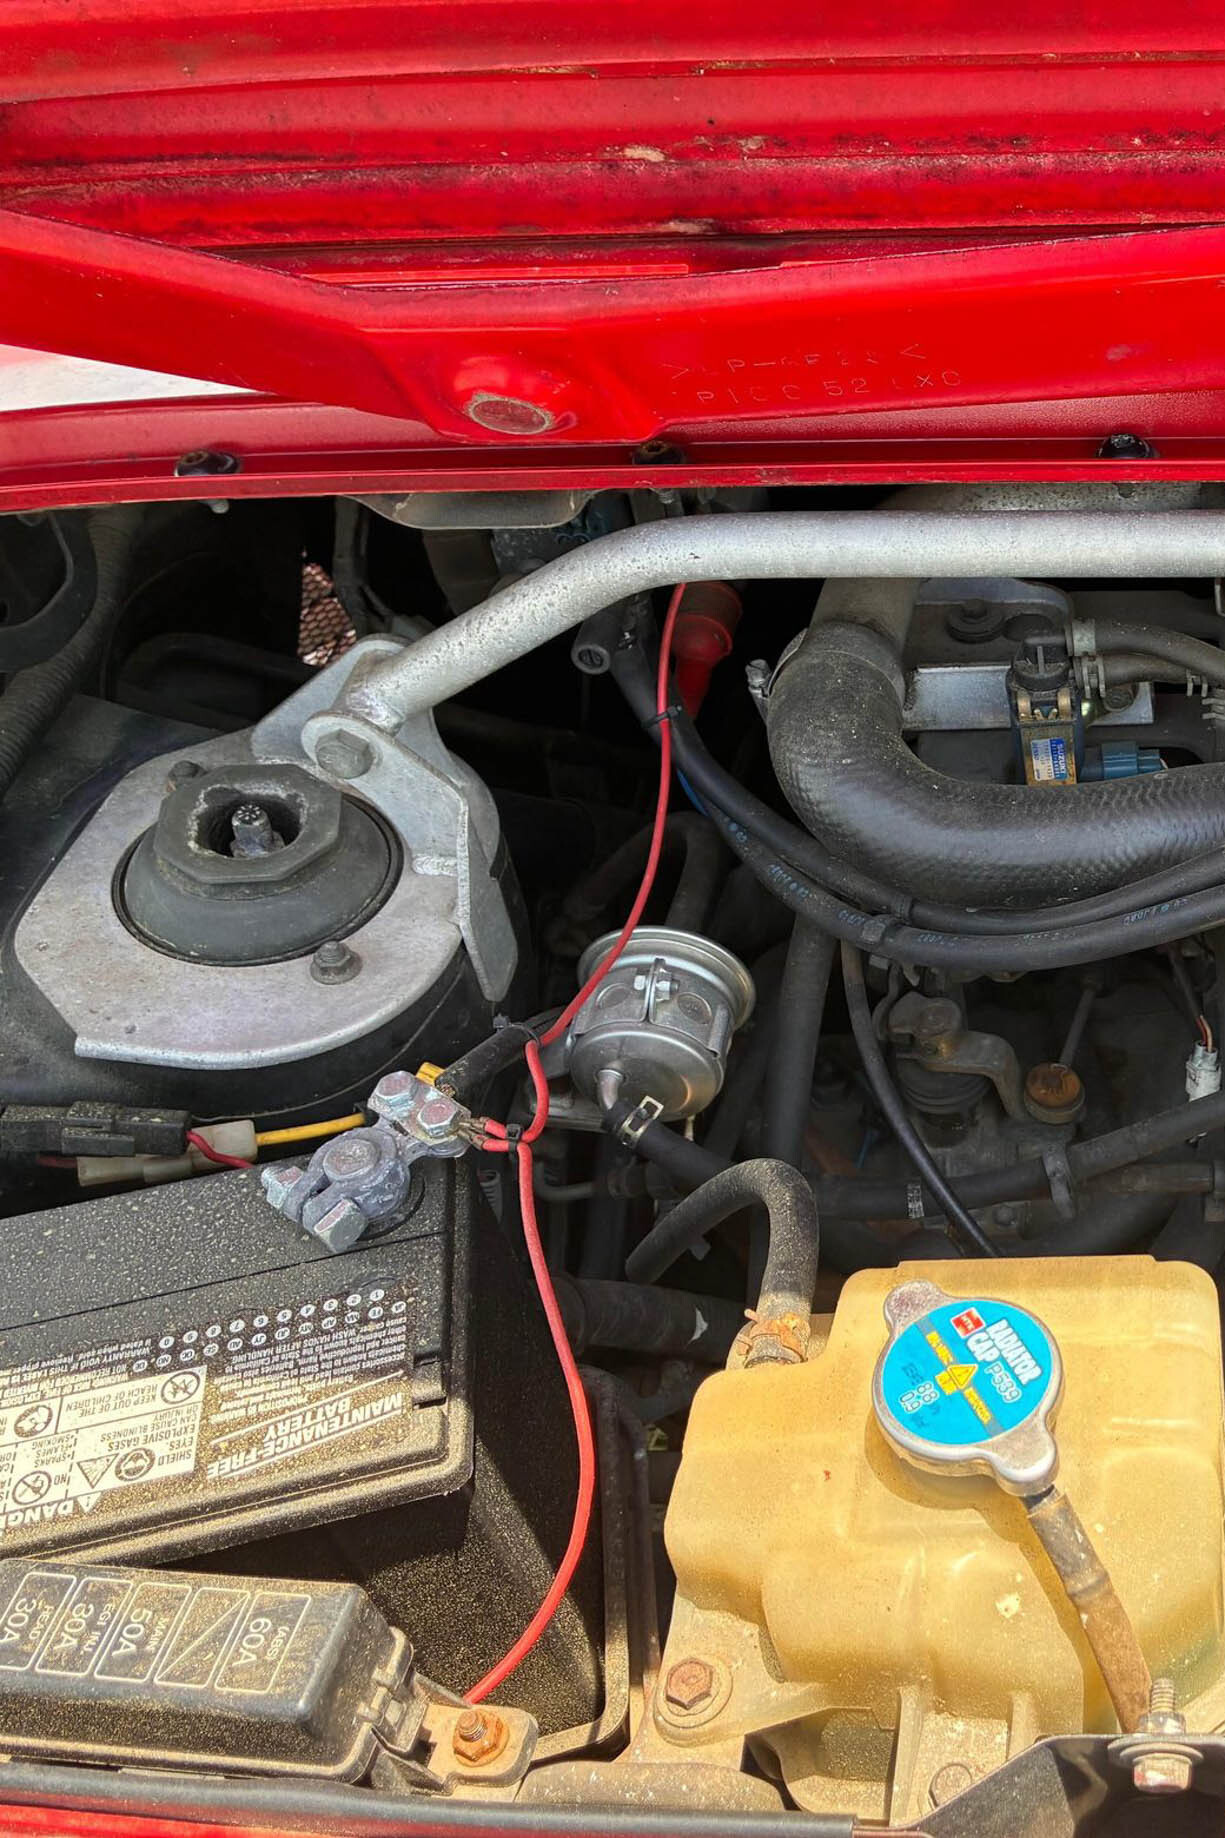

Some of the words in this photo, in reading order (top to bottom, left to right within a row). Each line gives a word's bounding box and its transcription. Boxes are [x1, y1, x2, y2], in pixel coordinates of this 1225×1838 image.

[1057, 743, 1067, 774] SUZUKI
[302, 1333, 330, 1347] HANDS
[331, 1327, 356, 1340] WASH
[100, 1346, 151, 1363] WARRANTY
[274, 1340, 300, 1354] AFTER
[986, 1318, 1043, 1385] RADIATOR
[47, 1364, 68, 1375] THIS
[78, 1357, 100, 1369] VOID
[966, 1331, 1001, 1362] CAP
[985, 1361, 1022, 1403] P539
[113, 1390, 125, 1401] OF
[127, 1383, 157, 1398] REACH
[132, 1392, 156, 1406] KEEP
[916, 1380, 940, 1404] 88
[65, 1393, 111, 1411] CHILDREN
[97, 1402, 110, 1414] OF
[112, 1398, 131, 1411] OUT
[186, 1404, 198, 1414] OR
[899, 1389, 921, 1415] 0.9
[78, 1405, 95, 1418] THE
[179, 1412, 197, 1424] CAN
[262, 1396, 351, 1443] BATTERY
[99, 1423, 147, 1442] BLINDNESS
[140, 1422, 195, 1445] EXPLOSIVE
[149, 1417, 177, 1432] CAUSE
[107, 1436, 139, 1452] GASES
[205, 1391, 401, 1481] MAINTENANCE-FREE
[157, 1447, 192, 1466] SHIELD
[53, 1472, 66, 1485] NO
[0, 1597, 37, 1644] 30A
[29, 1604, 54, 1640] HEAD
[53, 1603, 95, 1650] 30A
[112, 1607, 153, 1657] 50A
[146, 1617, 173, 1652] MAIN
[231, 1617, 272, 1667] 60A
[267, 1625, 290, 1660] (ABS)
